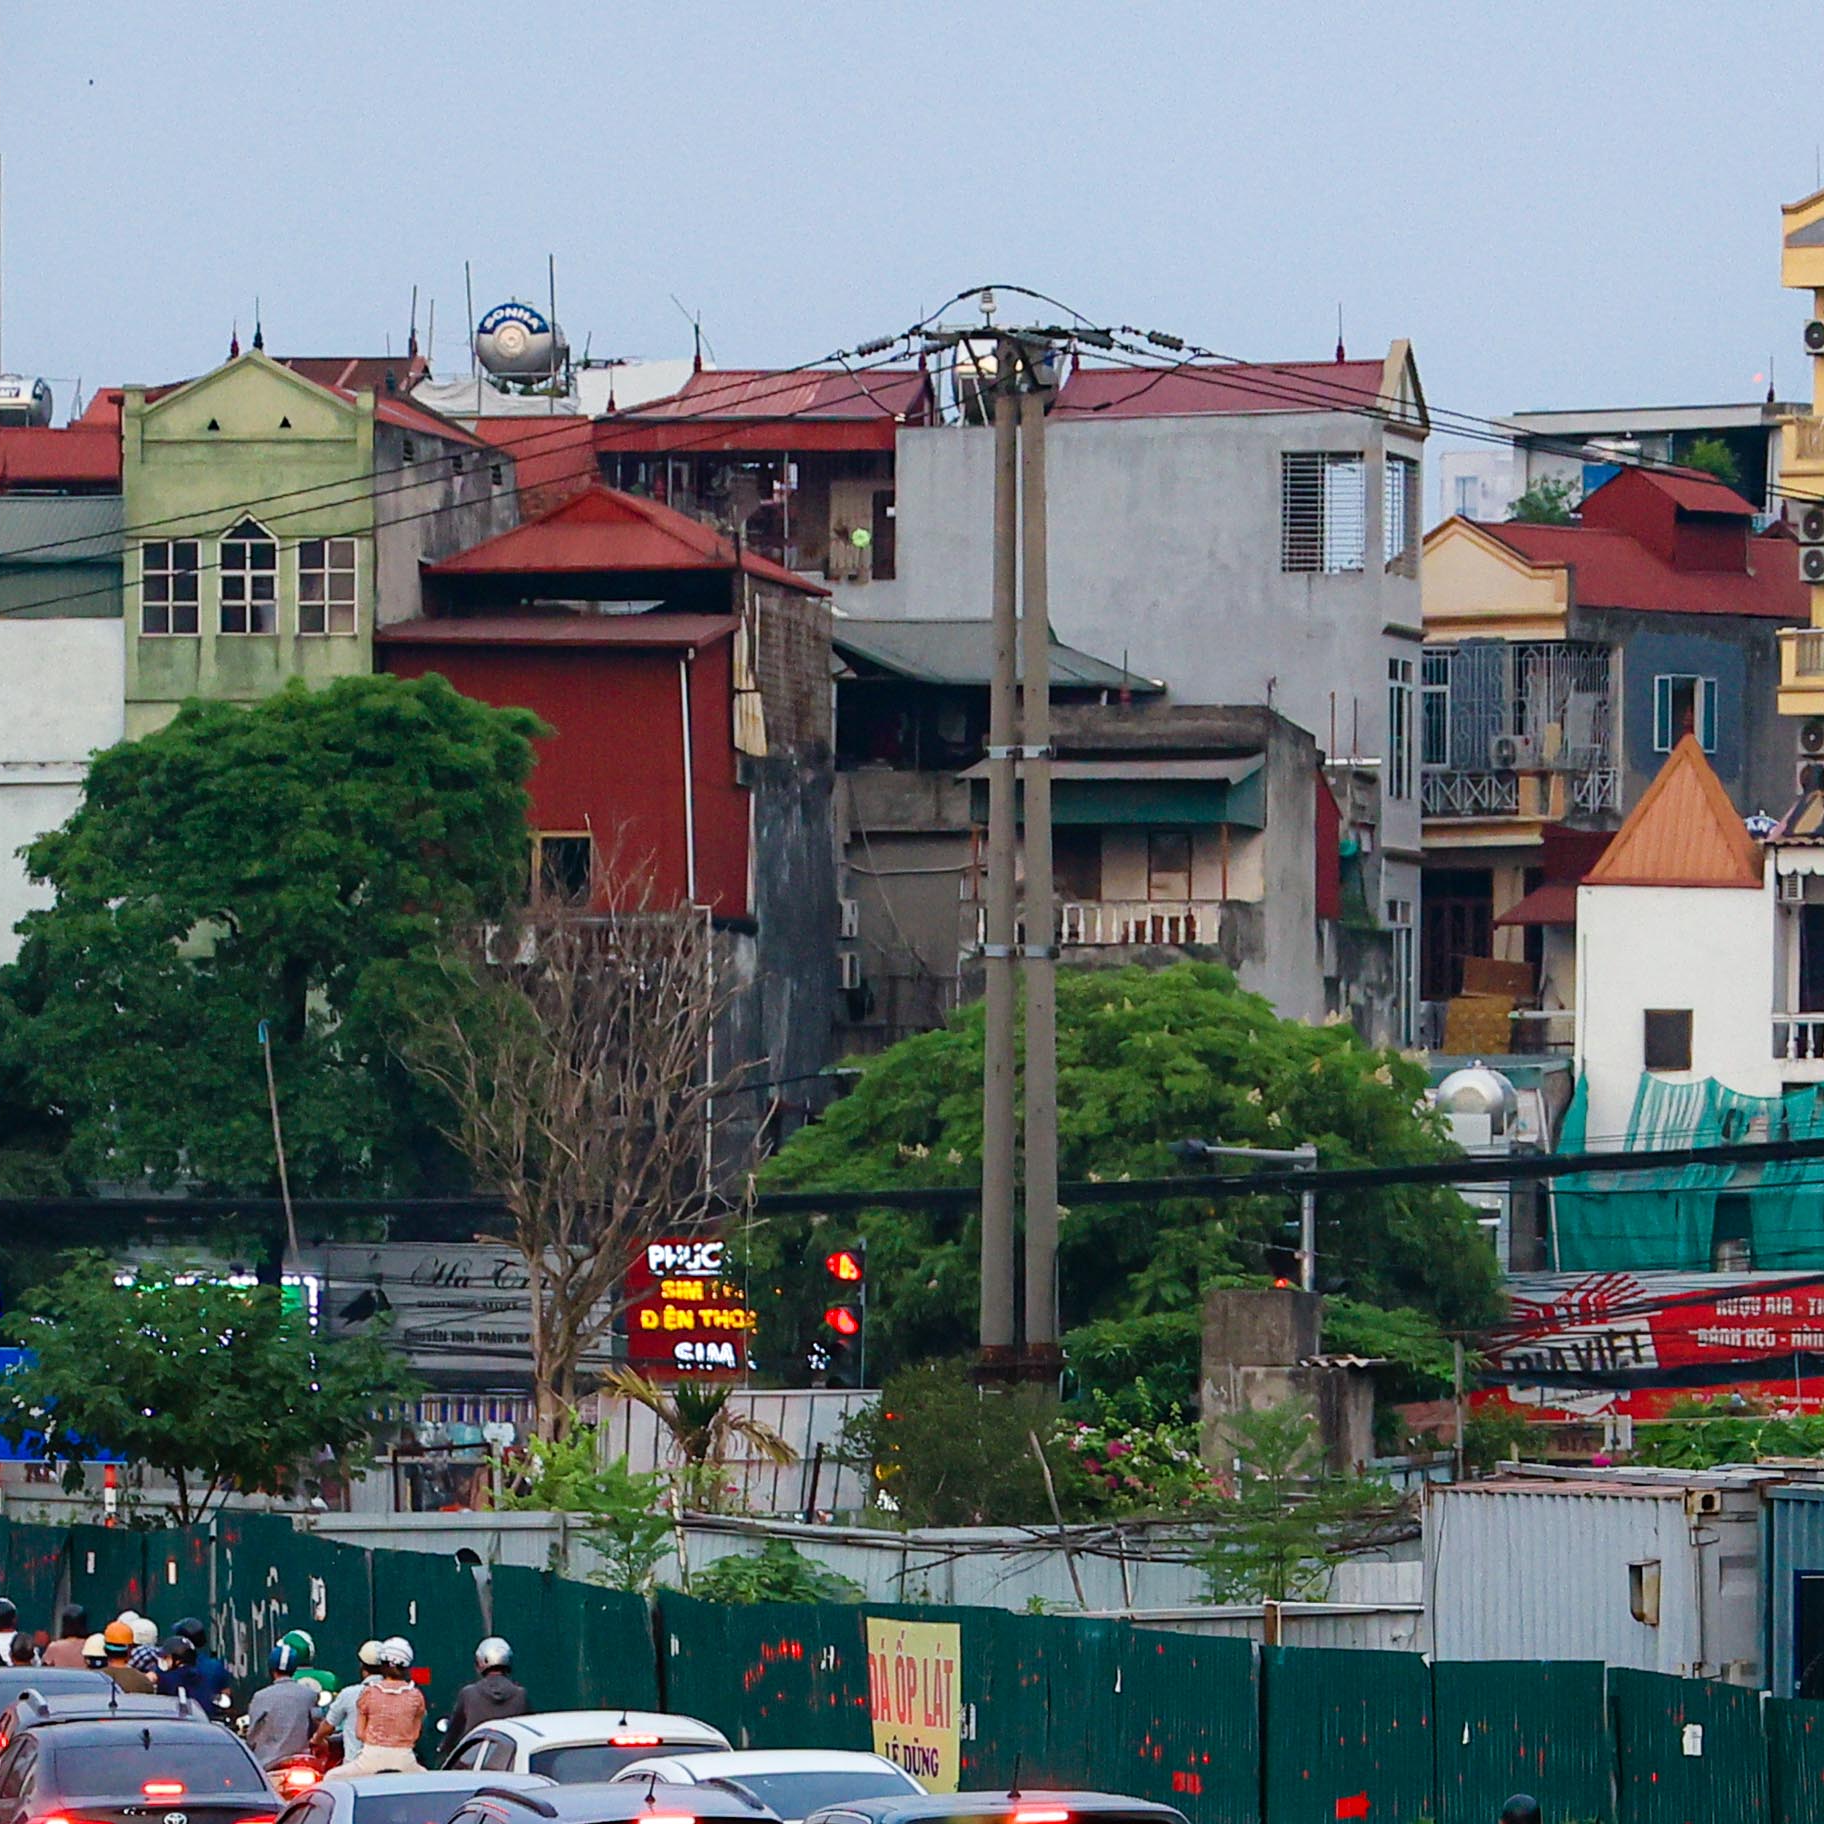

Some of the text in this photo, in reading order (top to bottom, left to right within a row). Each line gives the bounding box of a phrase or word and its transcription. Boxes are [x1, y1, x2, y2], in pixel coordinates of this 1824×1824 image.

[661, 1280, 705, 1301] SIM
[895, 1629, 917, 1726] ỐP
[924, 1642, 954, 1729] LÁT
[903, 1737, 939, 1778] DŨNG
